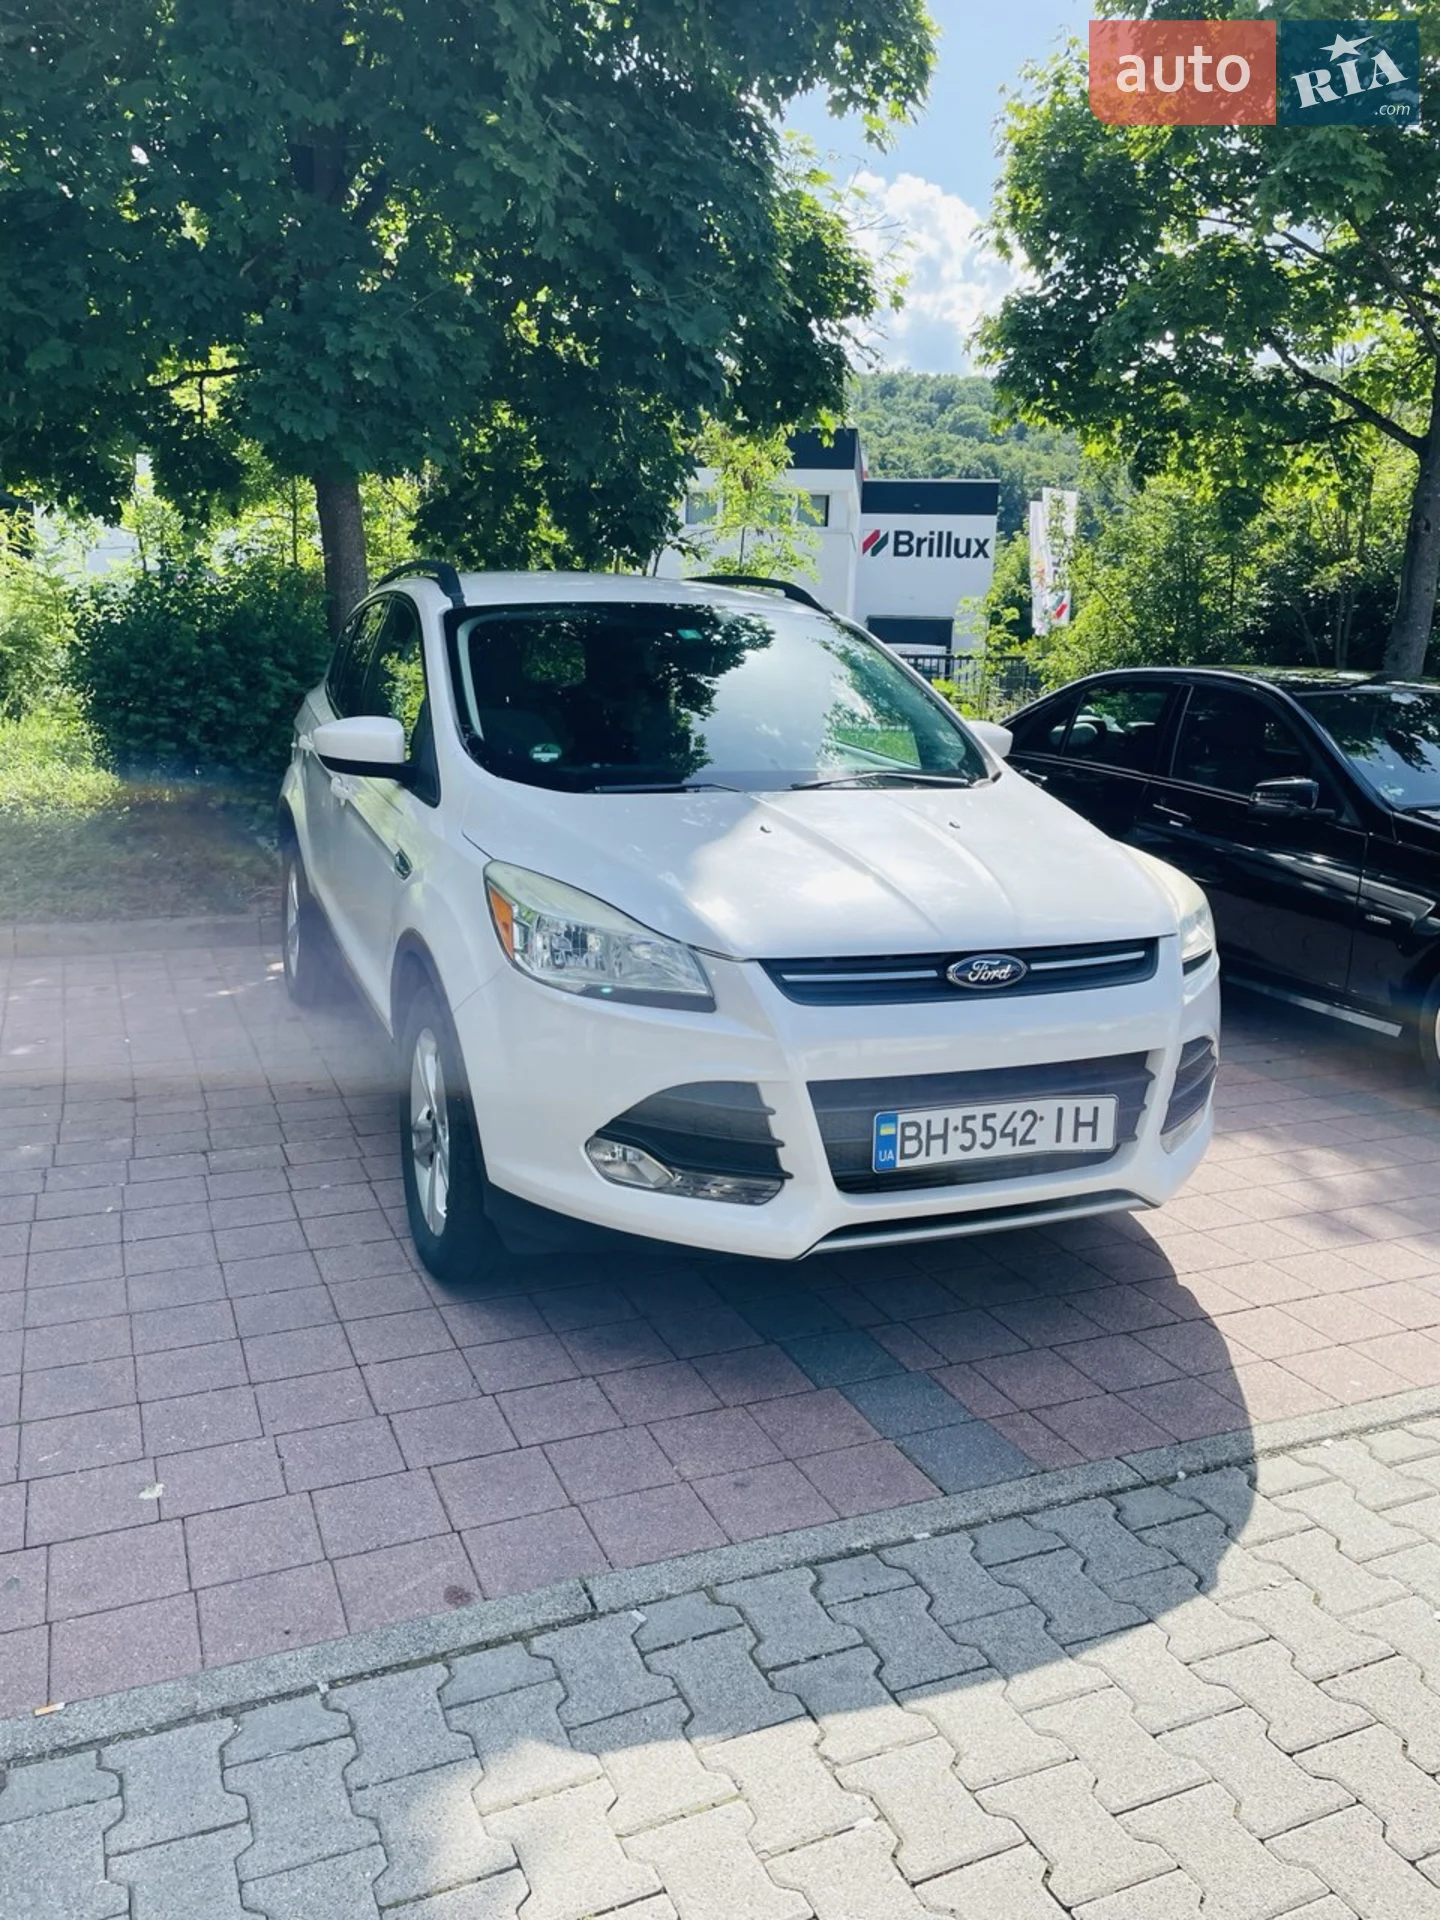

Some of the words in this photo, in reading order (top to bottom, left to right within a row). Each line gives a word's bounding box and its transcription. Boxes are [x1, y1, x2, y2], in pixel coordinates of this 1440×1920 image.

[893, 529, 990, 559] Brillux
[967, 959, 1012, 982] Ford
[899, 1117, 950, 1161] BH
[958, 1109, 1038, 1153] 5542
[1055, 1106, 1099, 1144] IH
[878, 1149, 895, 1162] UA
